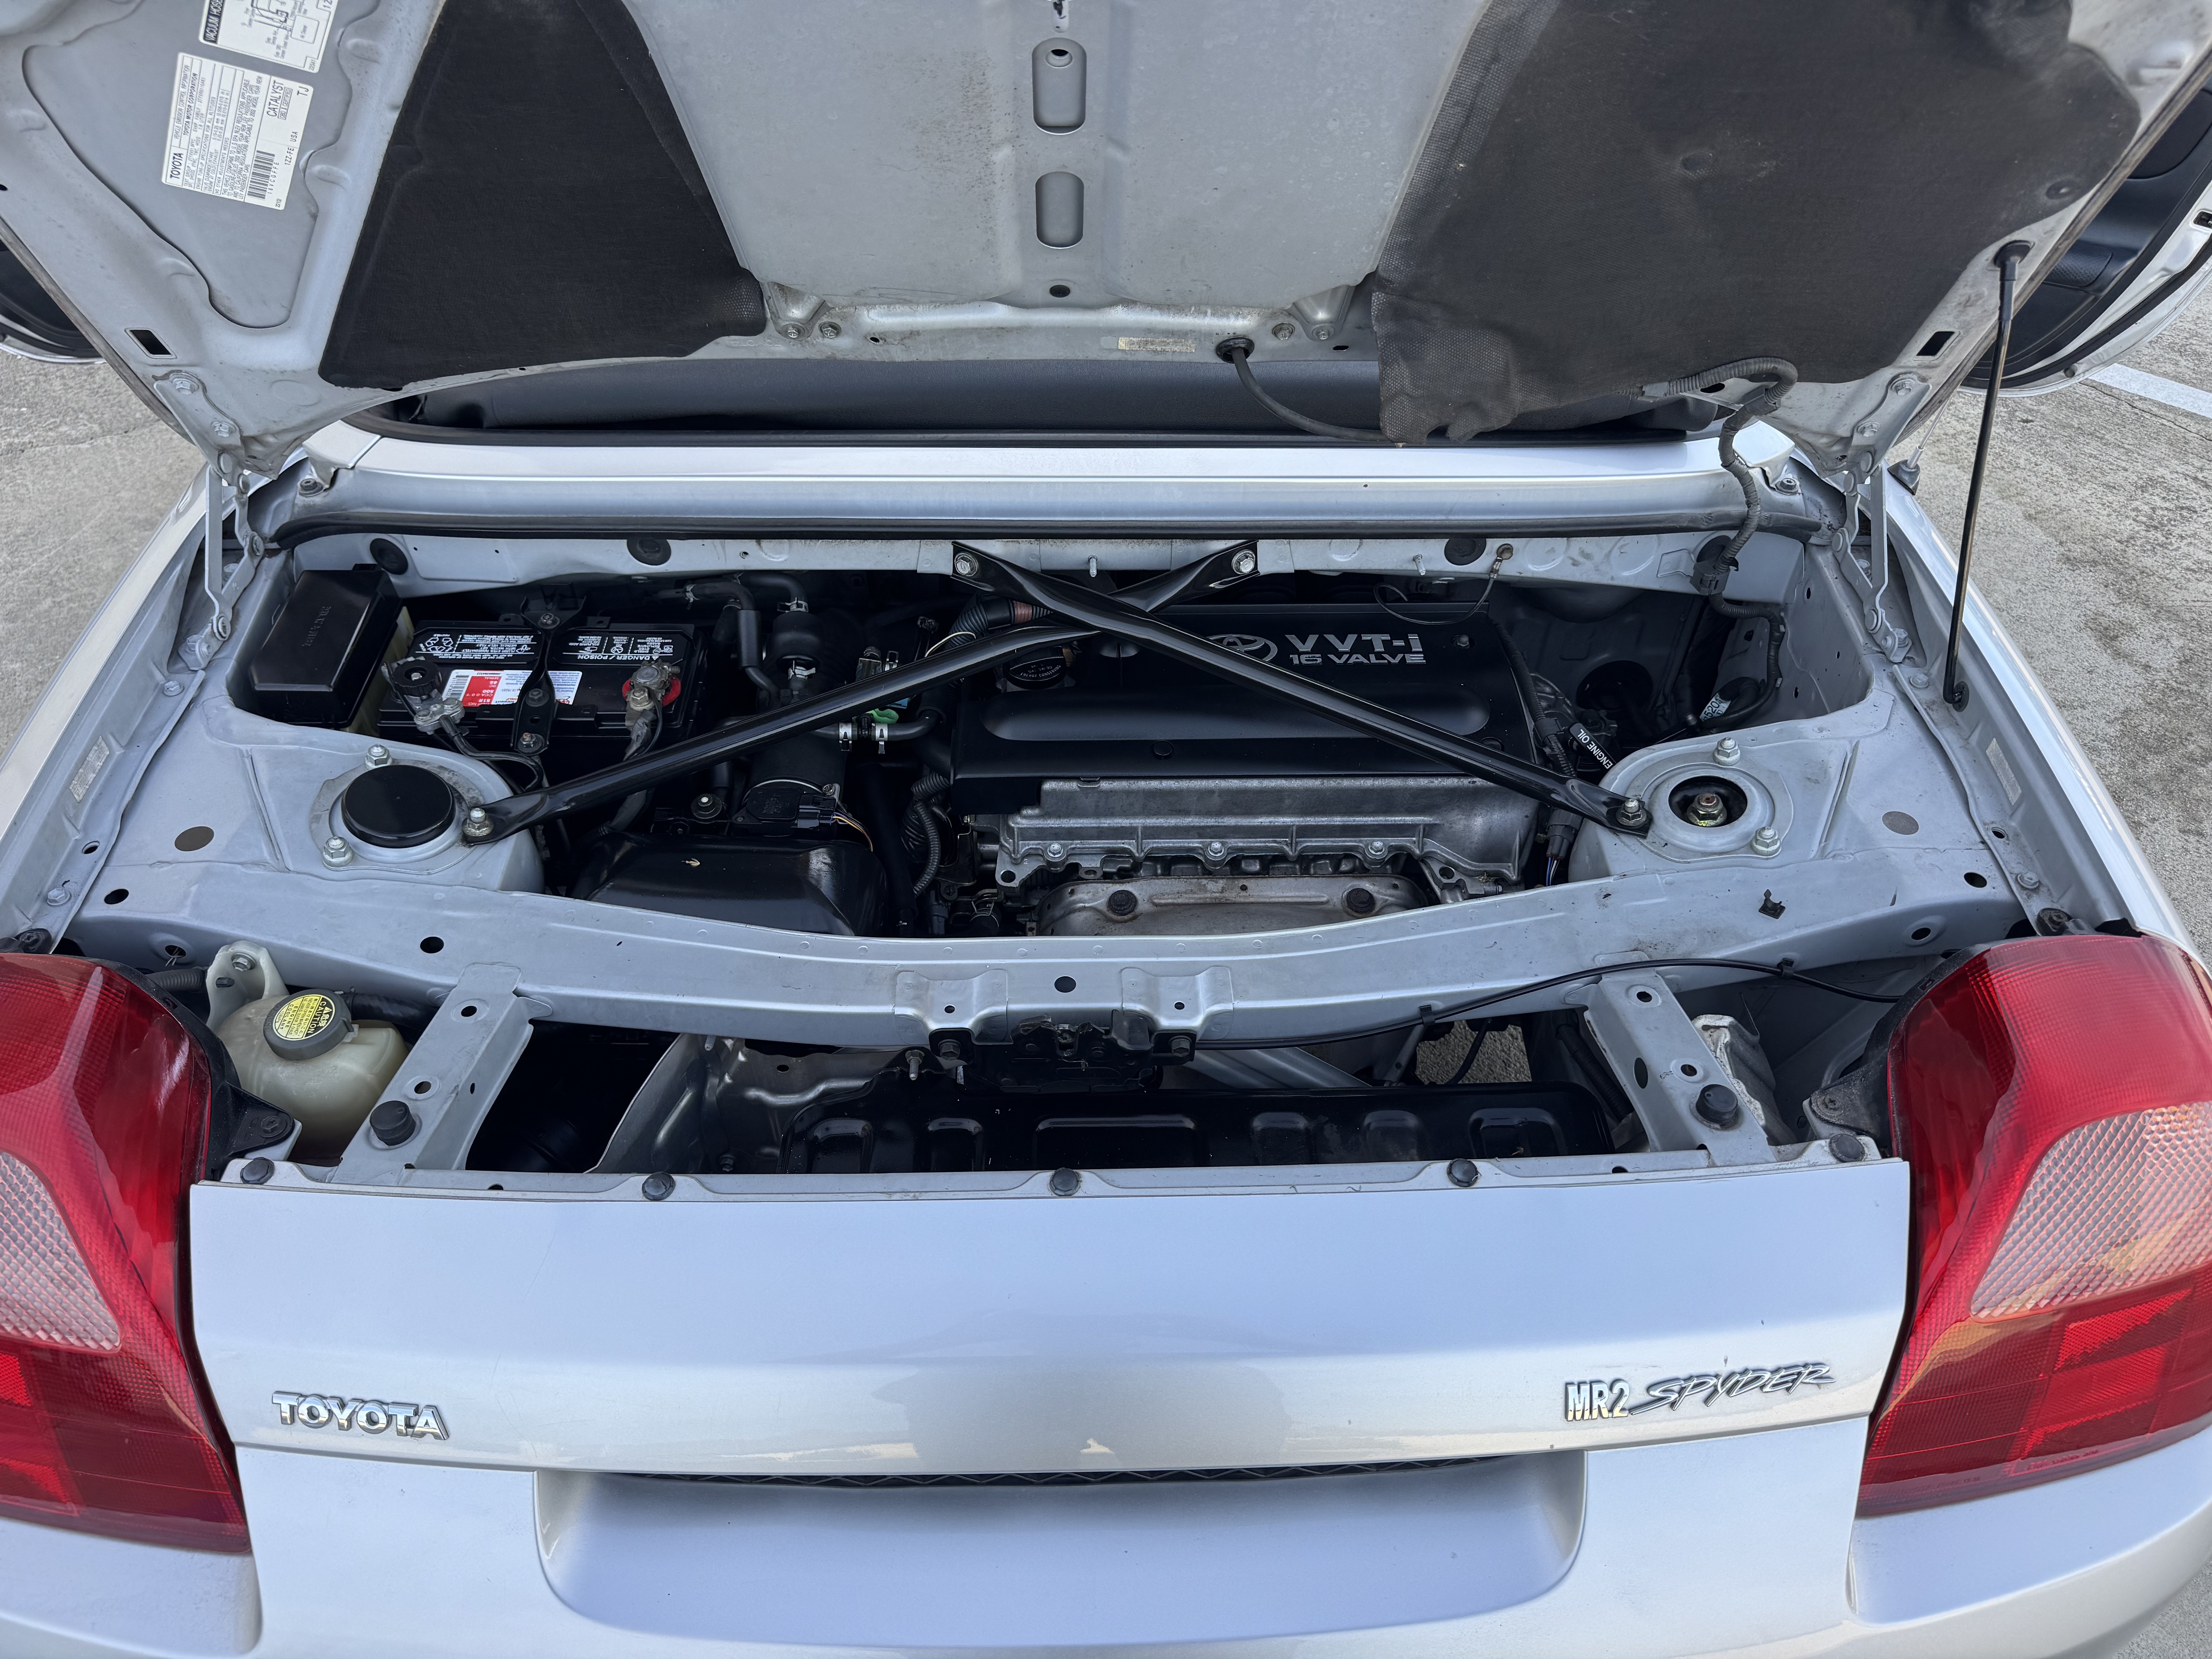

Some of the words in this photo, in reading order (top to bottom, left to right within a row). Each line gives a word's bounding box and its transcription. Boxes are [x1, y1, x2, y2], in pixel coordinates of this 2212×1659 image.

[206, 16, 219, 40] VACUUM
[181, 65, 189, 88] INFORMATION
[188, 73, 198, 103] CORPORATION
[267, 81, 283, 116] CATALYST
[282, 89, 291, 106] CERTIFIED
[297, 86, 309, 96] TJ
[236, 101, 246, 124] REGULATIONS
[241, 79, 249, 100] APPLICABLE
[244, 95, 252, 115] PASSENGER
[244, 124, 253, 143] APPLICABLE
[201, 134, 209, 160] SPECIFICATIONS
[240, 144, 249, 165] REGULATIONS
[285, 147, 294, 165] 1ZZ-FE
[170, 153, 183, 178] TOYOTA
[1285, 633, 1423, 652] VVT-i
[1289, 654, 1322, 665] 16
[1328, 653, 1427, 665] VALVE
[1039, 665, 1061, 677] CONSERVING
[1578, 729, 1590, 743] OIL
[1587, 741, 1613, 769] ENGINE
[279, 1004, 294, 1030] COOLANT
[285, 1006, 298, 1028] ENGINE
[307, 1001, 326, 1034] CAUTION
[317, 1013, 329, 1027] 危険
[1565, 1379, 1630, 1422] MR2
[1630, 1363, 1836, 1415] SPYDER
[272, 1391, 450, 1441] TOYOTA
